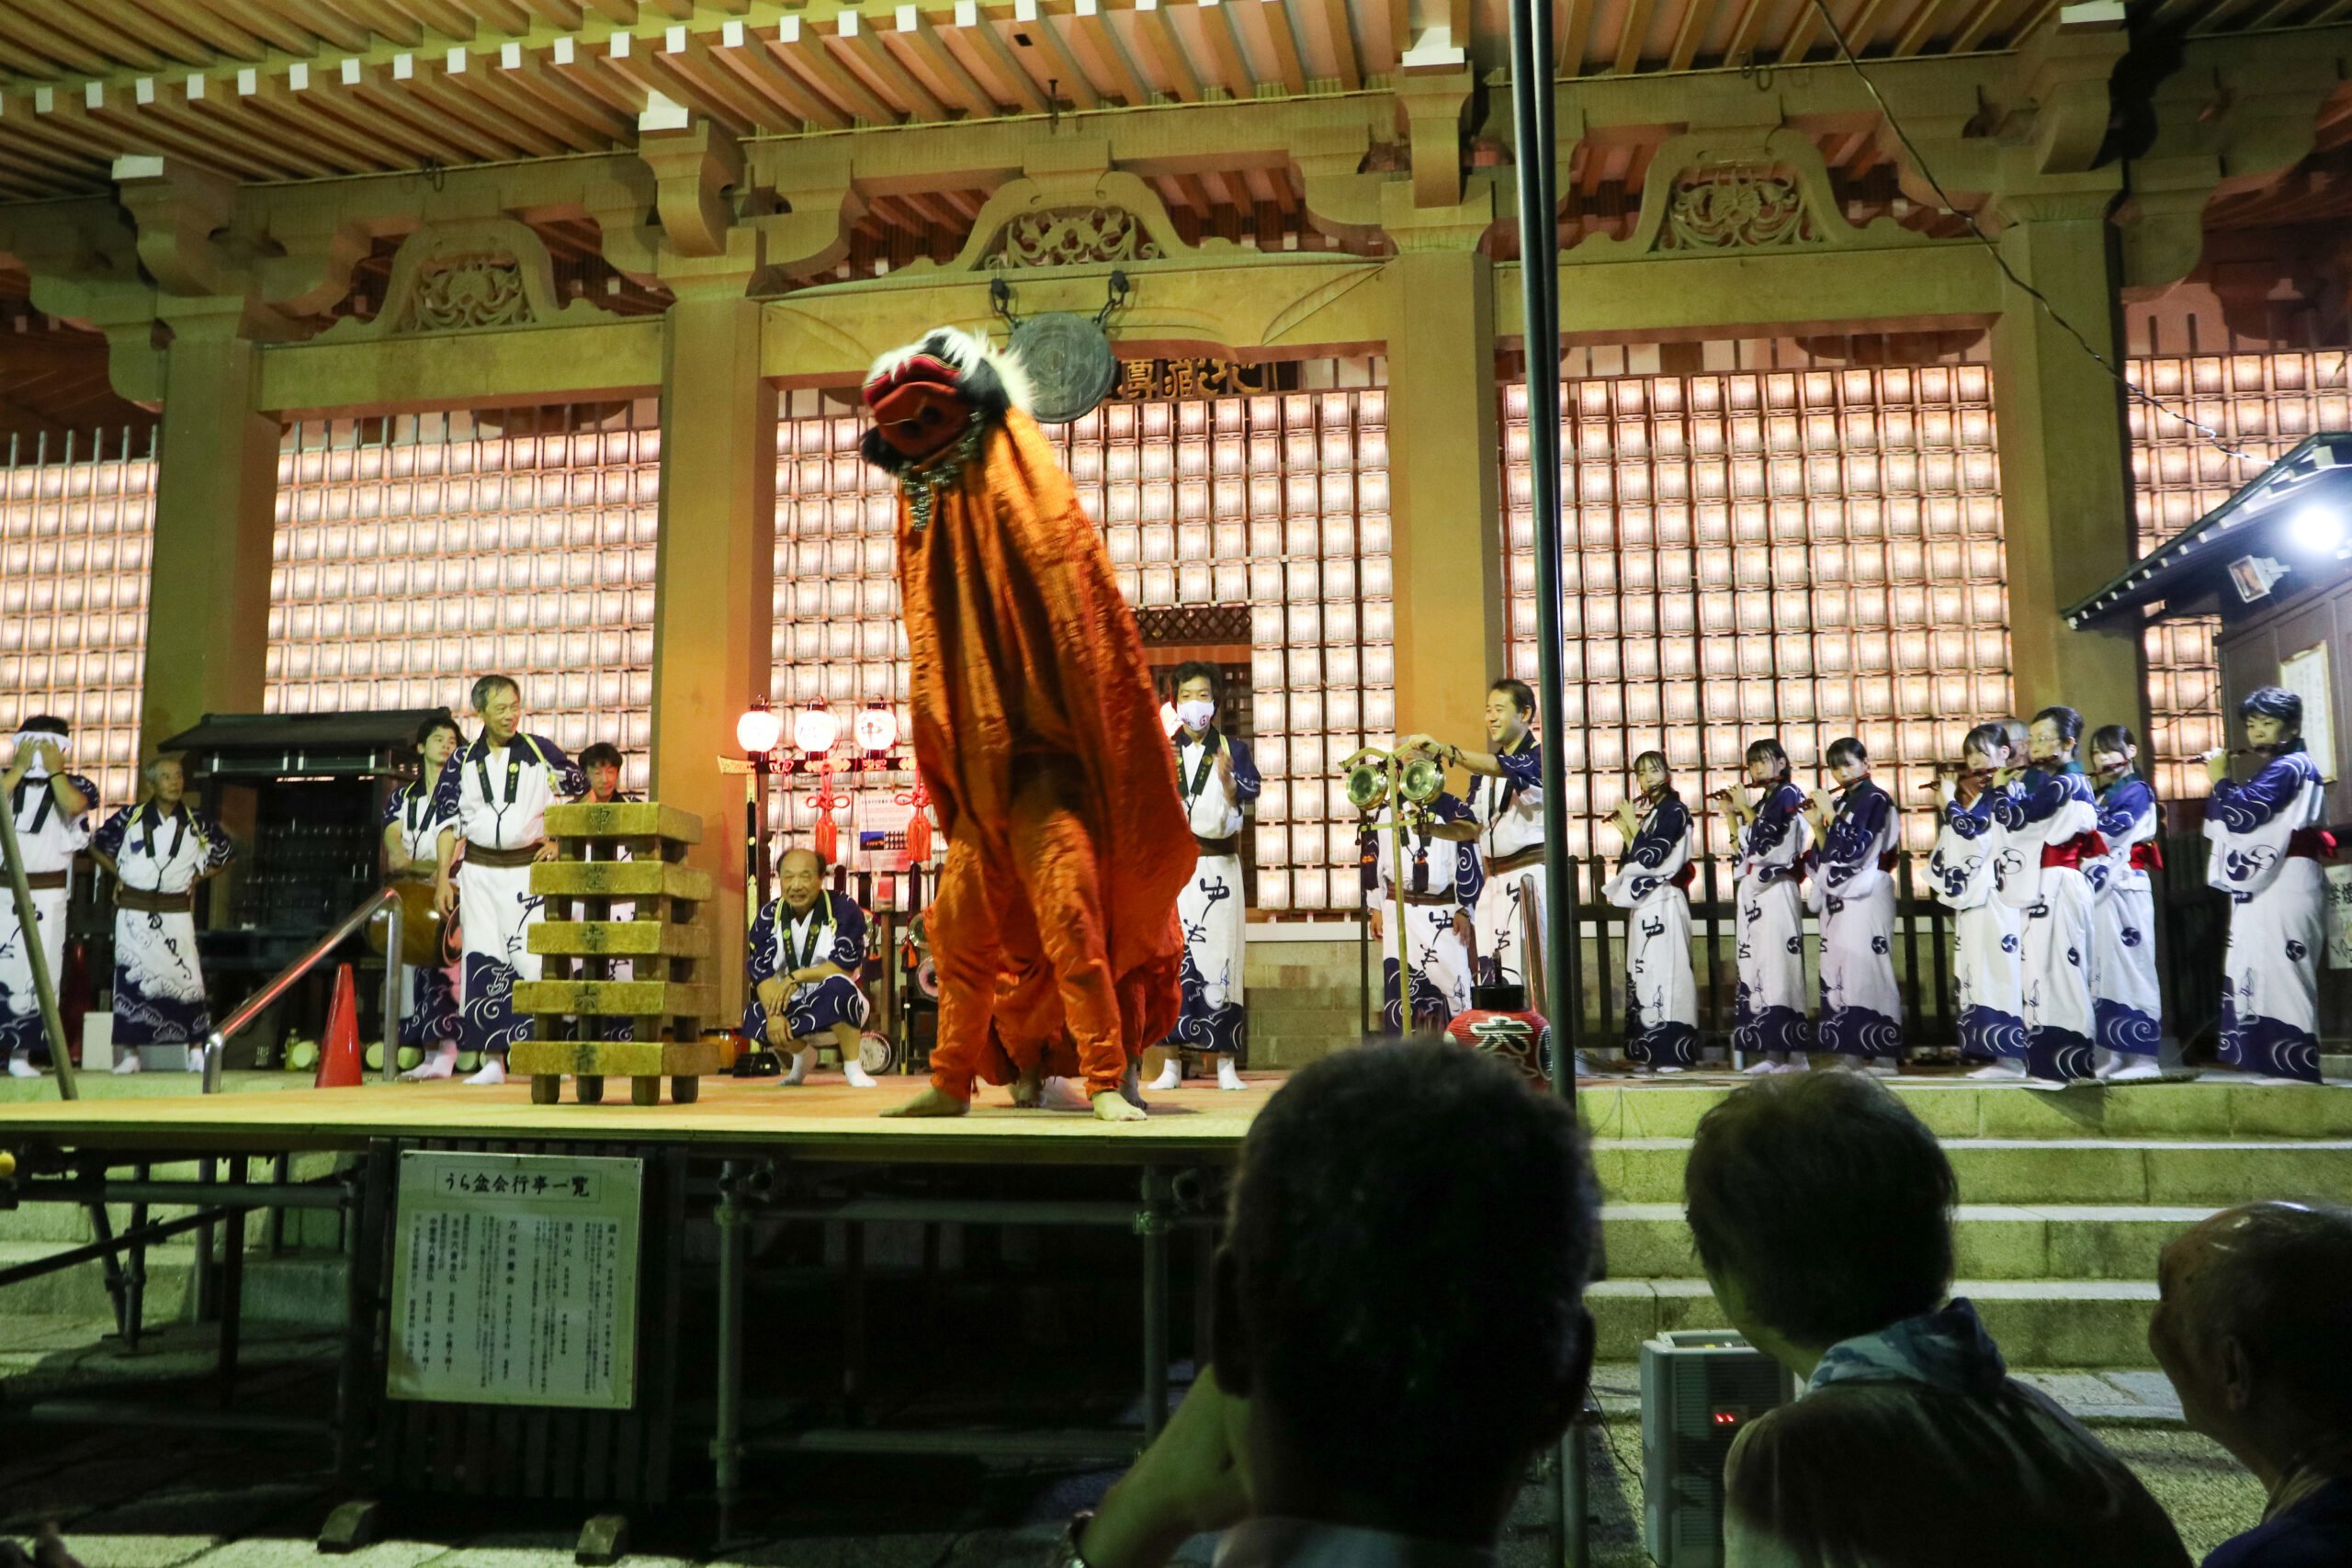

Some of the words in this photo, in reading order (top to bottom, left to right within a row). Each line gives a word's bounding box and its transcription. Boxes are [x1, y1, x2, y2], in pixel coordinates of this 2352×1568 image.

[446, 1173, 590, 1198] うら盆会行事一覧
